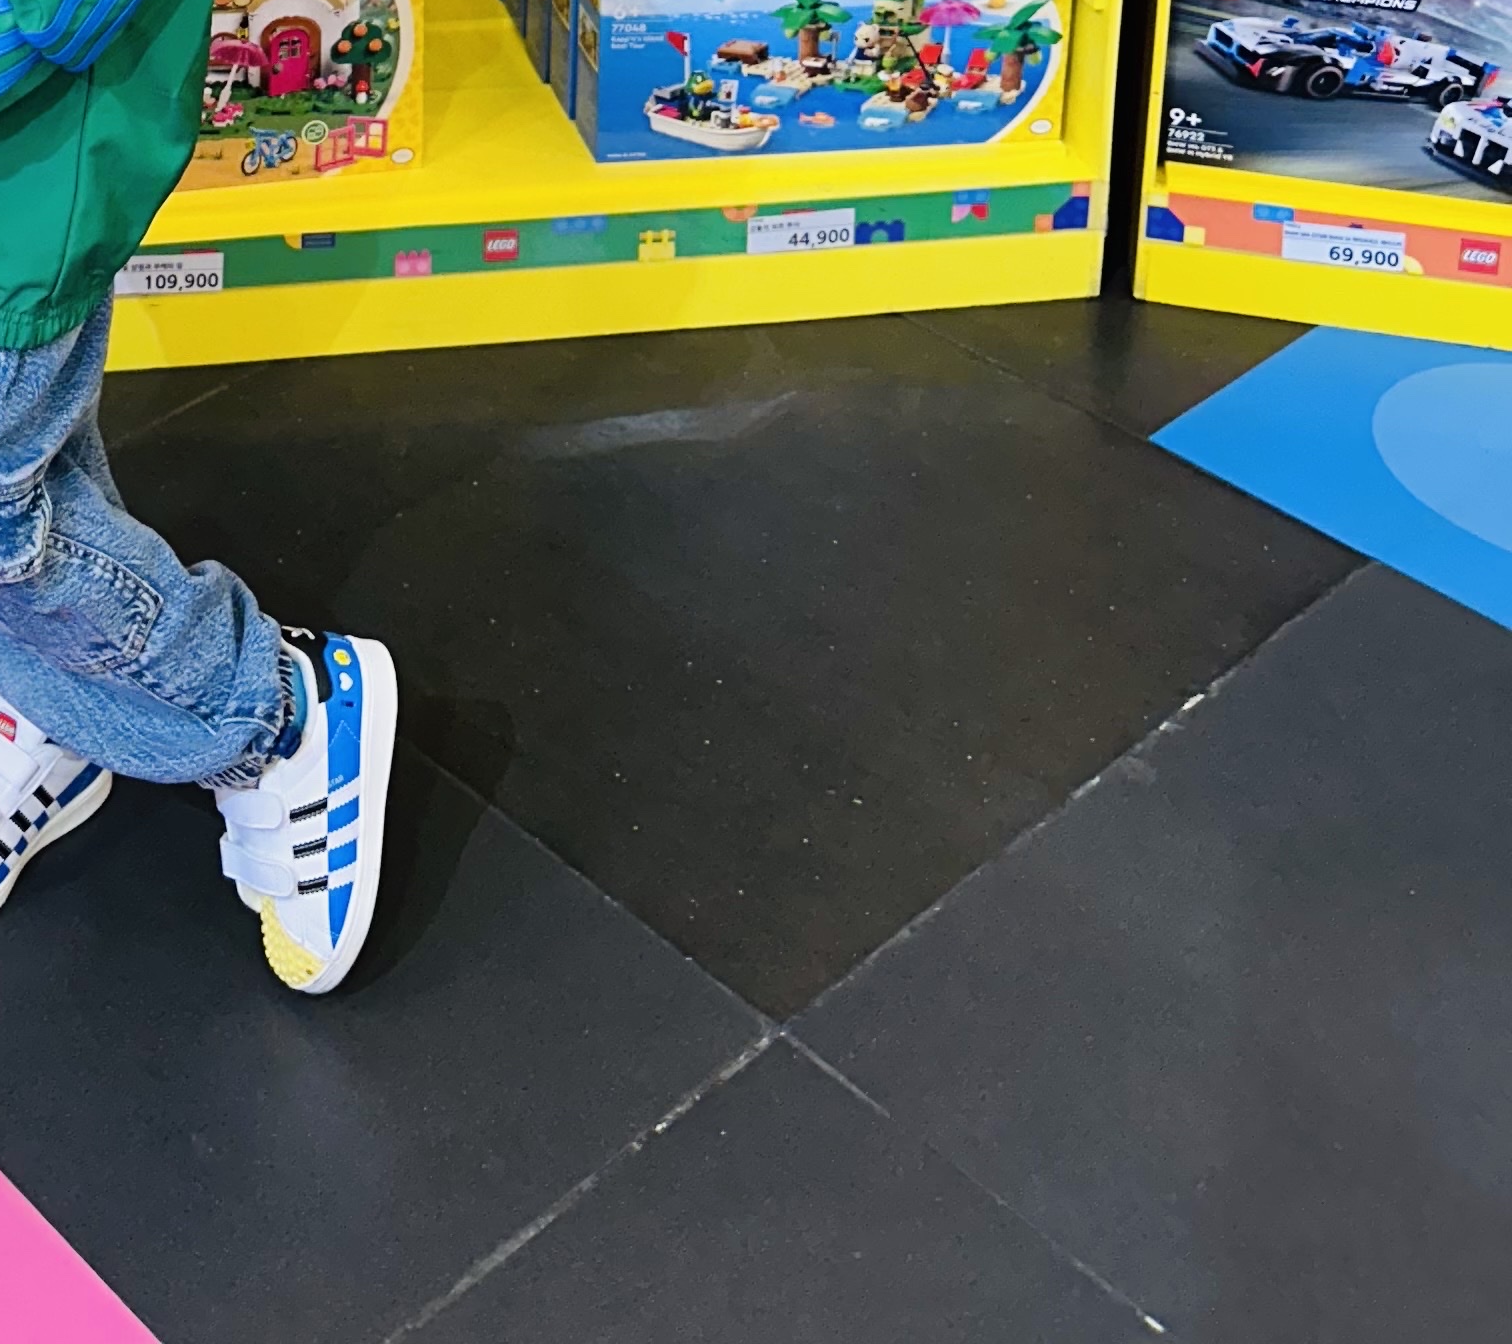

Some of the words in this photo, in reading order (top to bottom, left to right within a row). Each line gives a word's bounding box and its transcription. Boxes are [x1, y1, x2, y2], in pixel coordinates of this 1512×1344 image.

[611, 24, 646, 32] 77048
[1170, 108, 1202, 126] 9+
[1168, 128, 1205, 141] 76922
[487, 238, 516, 253] LEGO
[788, 229, 849, 248] 44,900
[1330, 246, 1399, 266] 69,900
[1462, 249, 1497, 263] LEGO
[146, 273, 218, 291] 109,900
